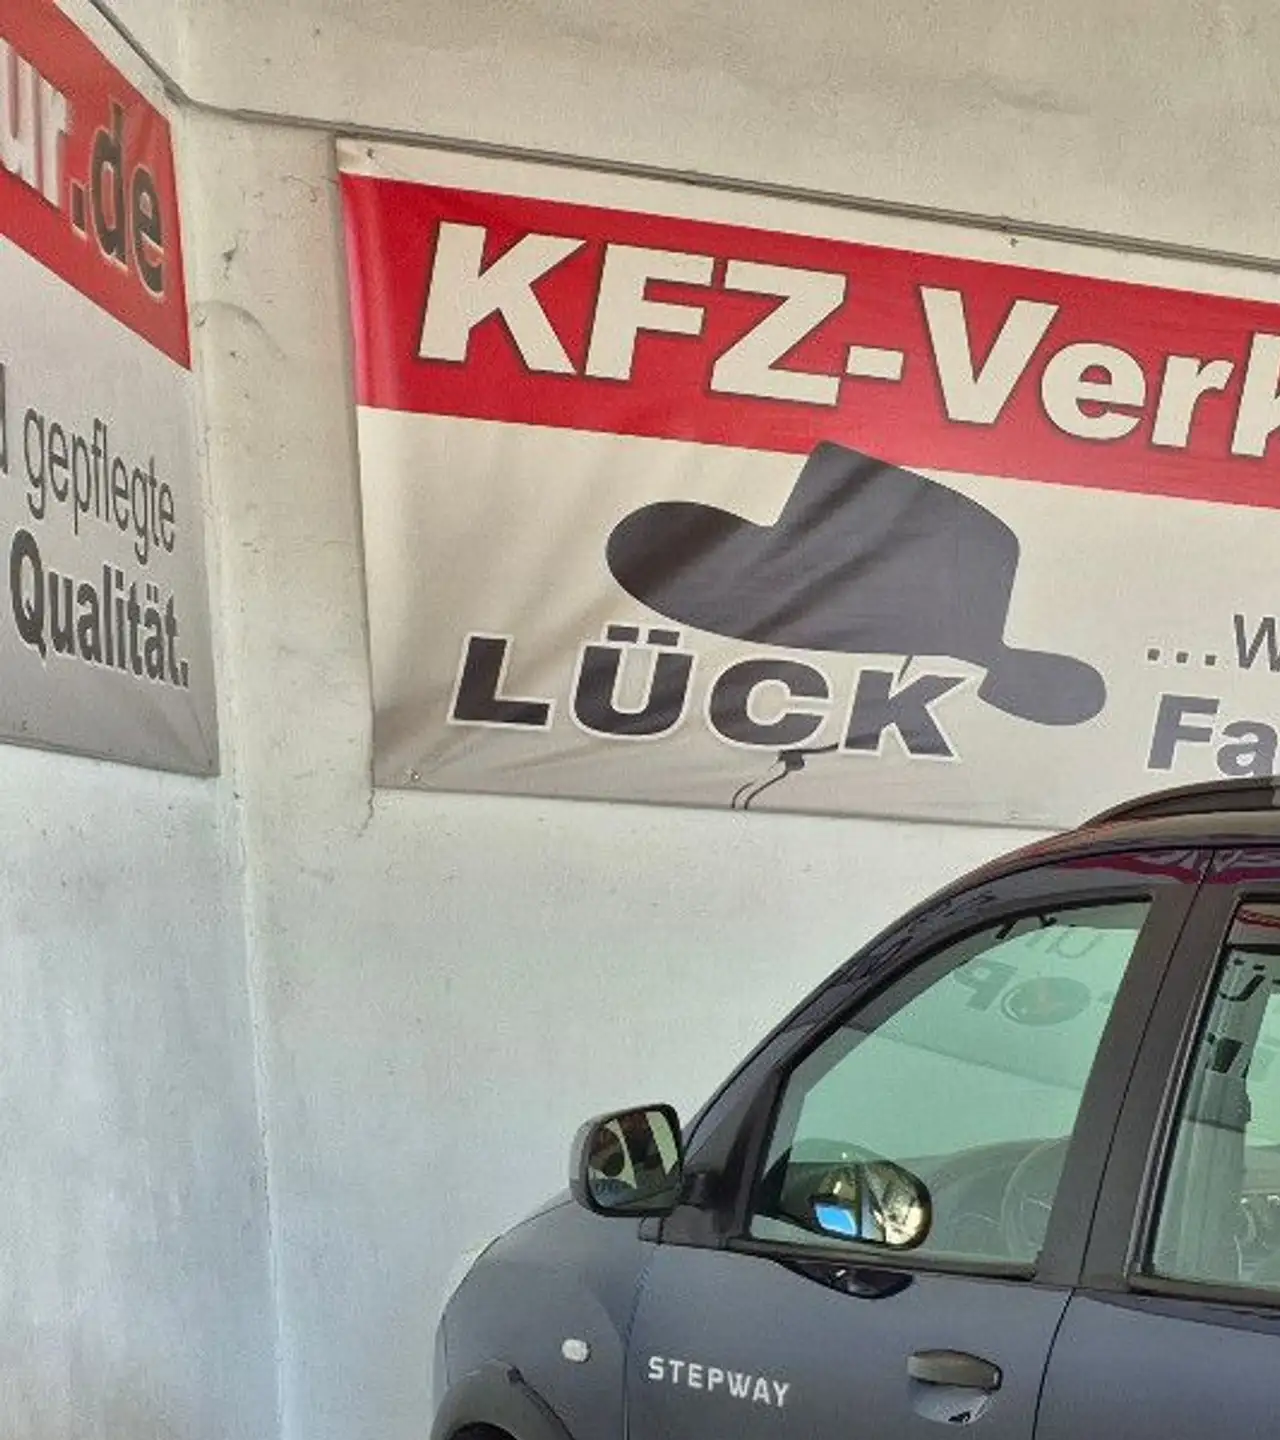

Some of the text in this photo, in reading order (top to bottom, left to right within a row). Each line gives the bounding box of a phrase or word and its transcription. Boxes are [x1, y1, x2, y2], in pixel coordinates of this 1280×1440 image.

[24, 407, 175, 565] gepflegte
[10, 528, 189, 687] Qualität.
[452, 625, 968, 757] LÜCK
[648, 1356, 790, 1407] STEPWAY
